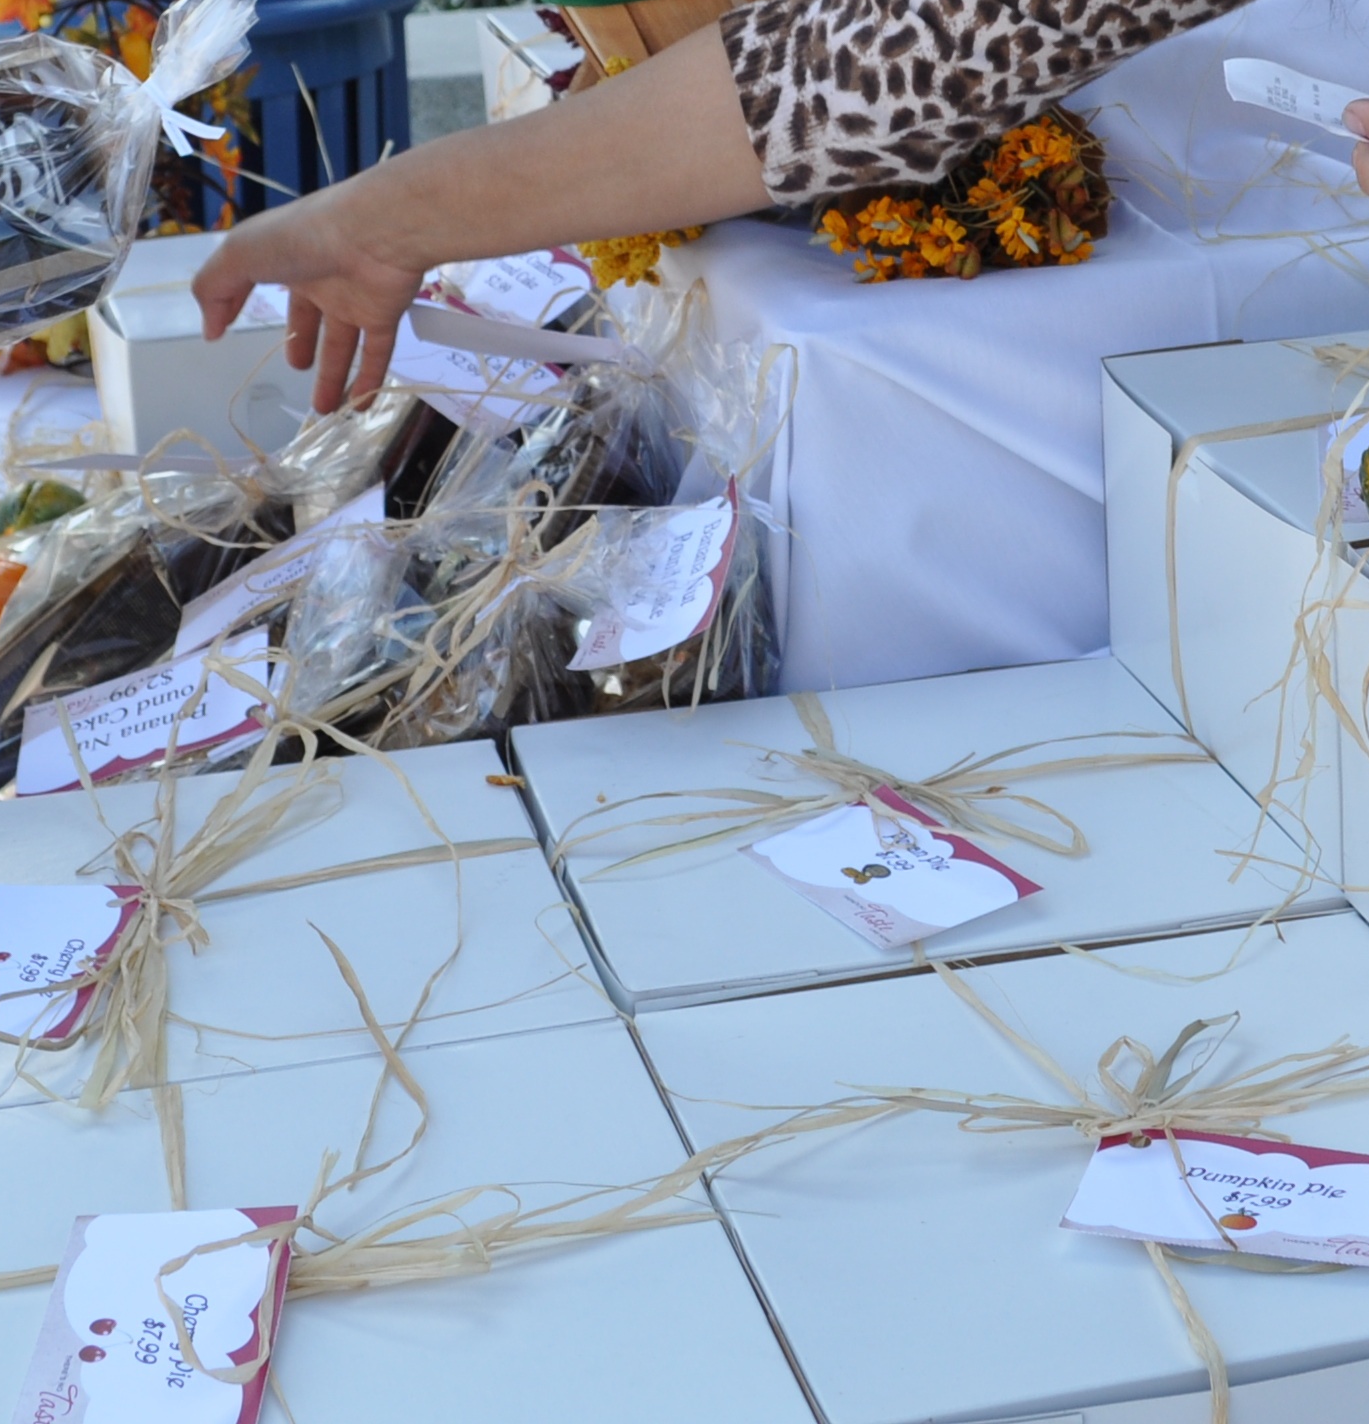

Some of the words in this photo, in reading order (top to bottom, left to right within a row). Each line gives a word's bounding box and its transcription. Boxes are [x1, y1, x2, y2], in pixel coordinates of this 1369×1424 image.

[690, 517, 722, 577] Banana
[108, 667, 175, 703] $2.99
[69, 732, 112, 757] Nu
[47, 938, 86, 978] Cherry
[1179, 1166, 1296, 1192] Pumpkin
[1297, 1182, 1347, 1199] Pie
[1222, 1190, 1293, 1209] $7.99
[134, 1317, 166, 1365] $7.99
